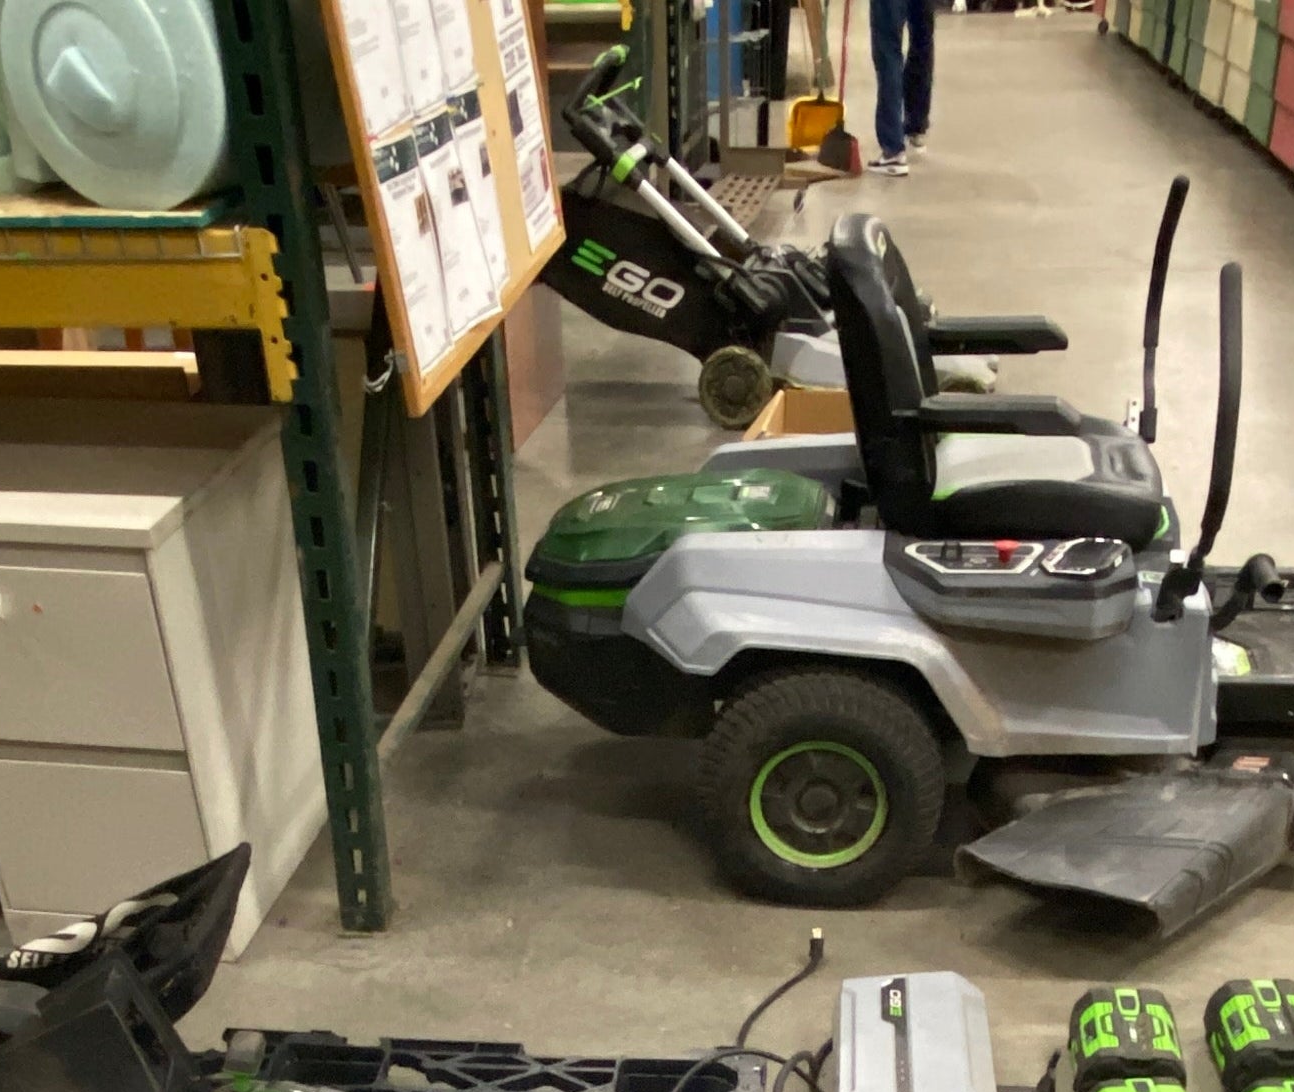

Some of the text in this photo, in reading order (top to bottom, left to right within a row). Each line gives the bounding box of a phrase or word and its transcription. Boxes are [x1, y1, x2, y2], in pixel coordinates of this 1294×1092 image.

[571, 238, 685, 309] EGO
[7, 950, 54, 969] SELF
[889, 989, 903, 1016] EGO
